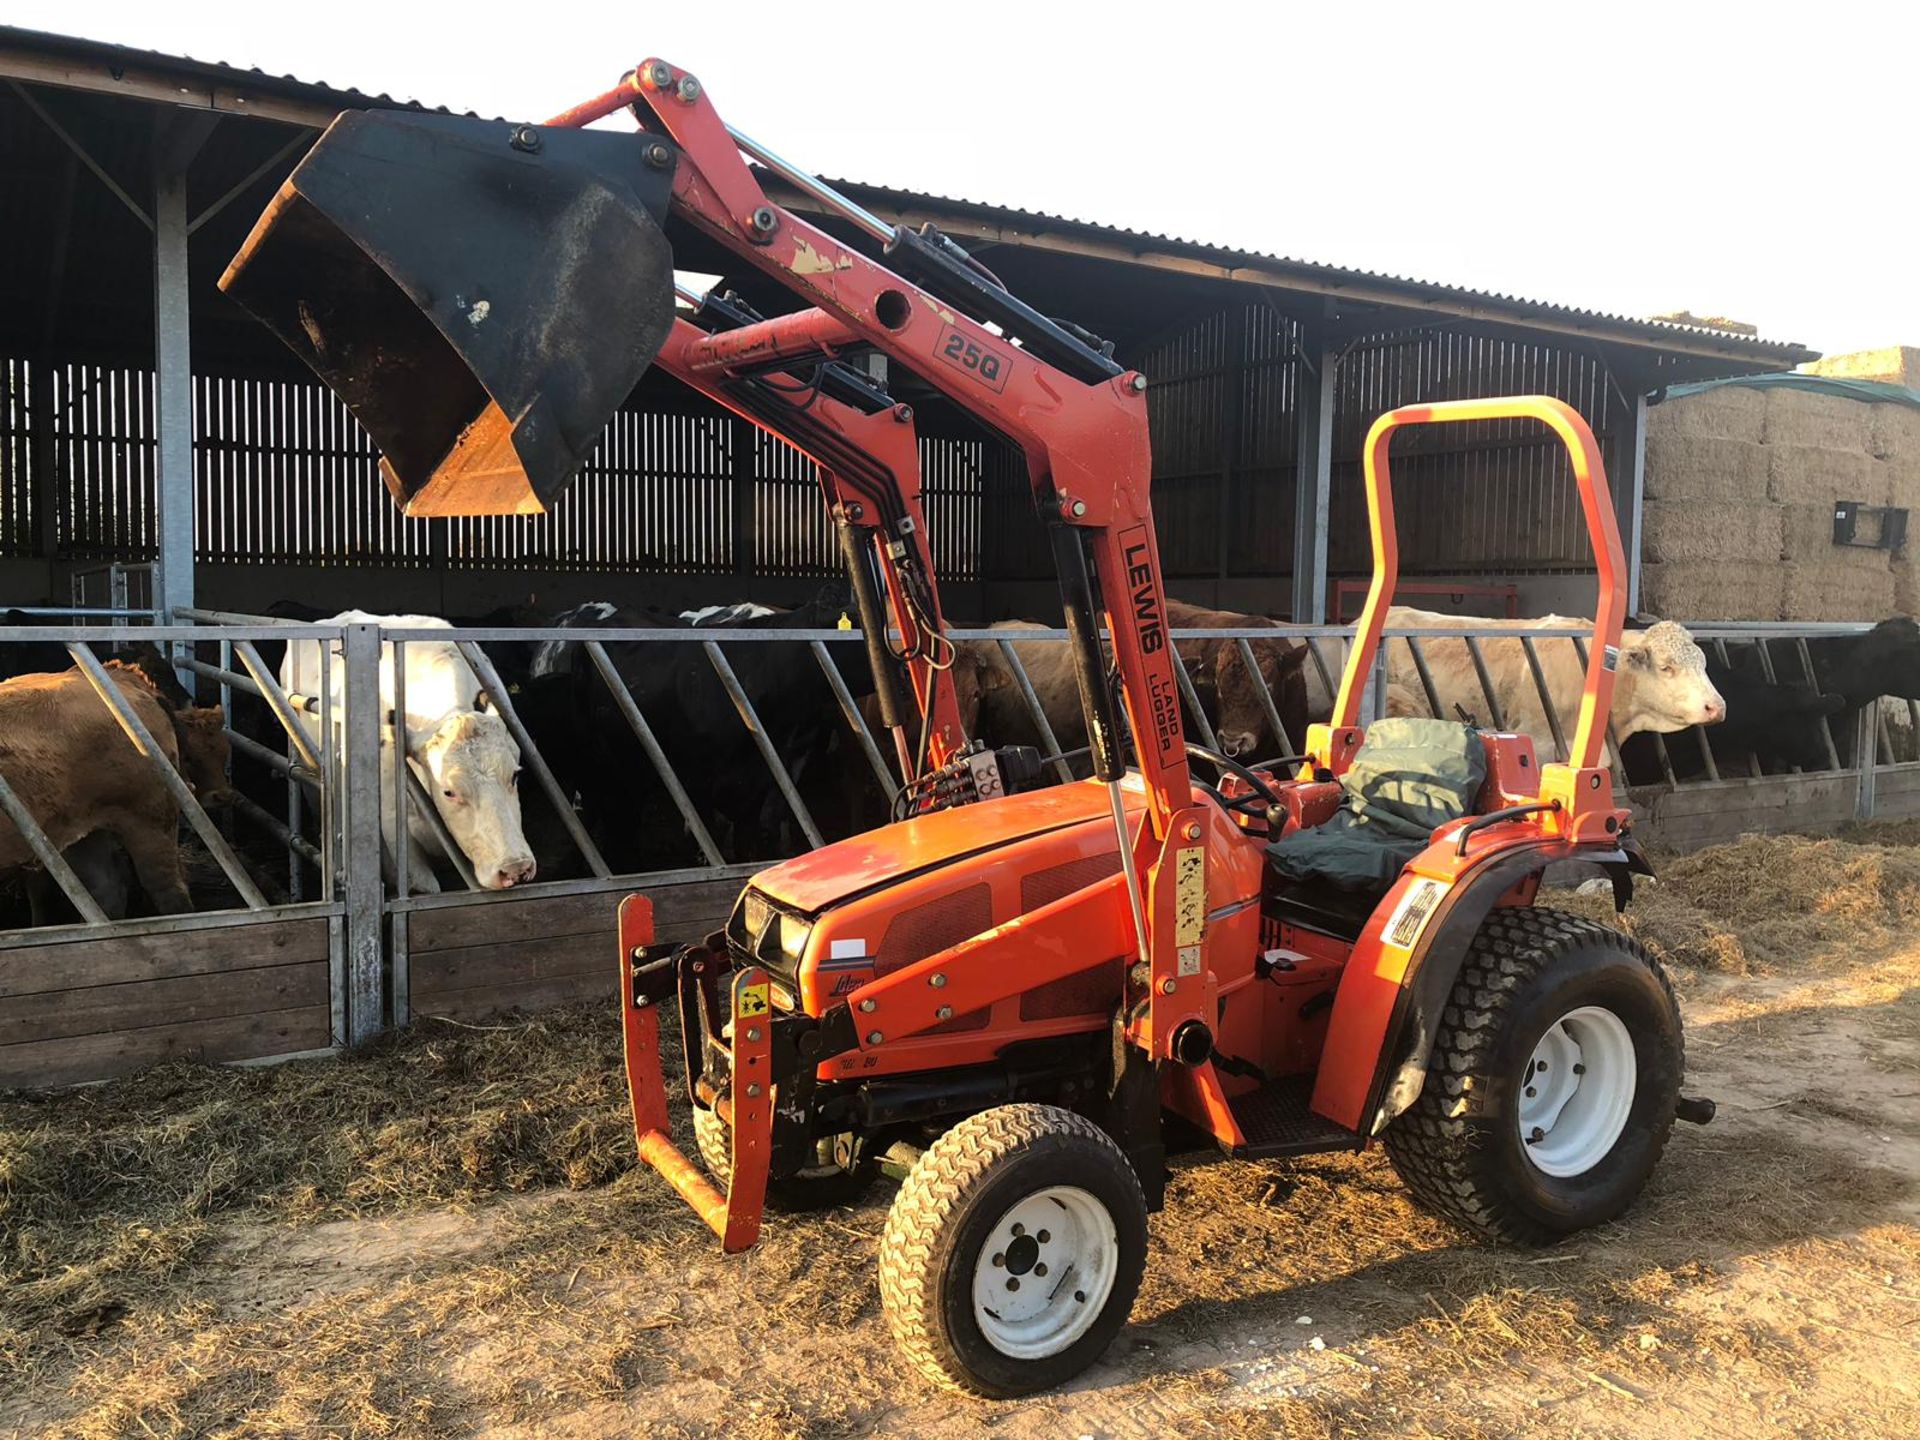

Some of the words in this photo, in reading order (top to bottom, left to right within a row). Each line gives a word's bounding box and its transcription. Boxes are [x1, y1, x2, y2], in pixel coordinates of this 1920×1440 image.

[944, 334, 1000, 380] 25Q
[1125, 543, 1163, 654] LEWIS
[1149, 673, 1171, 751] LUGGER
[1162, 681, 1179, 736] LAND
